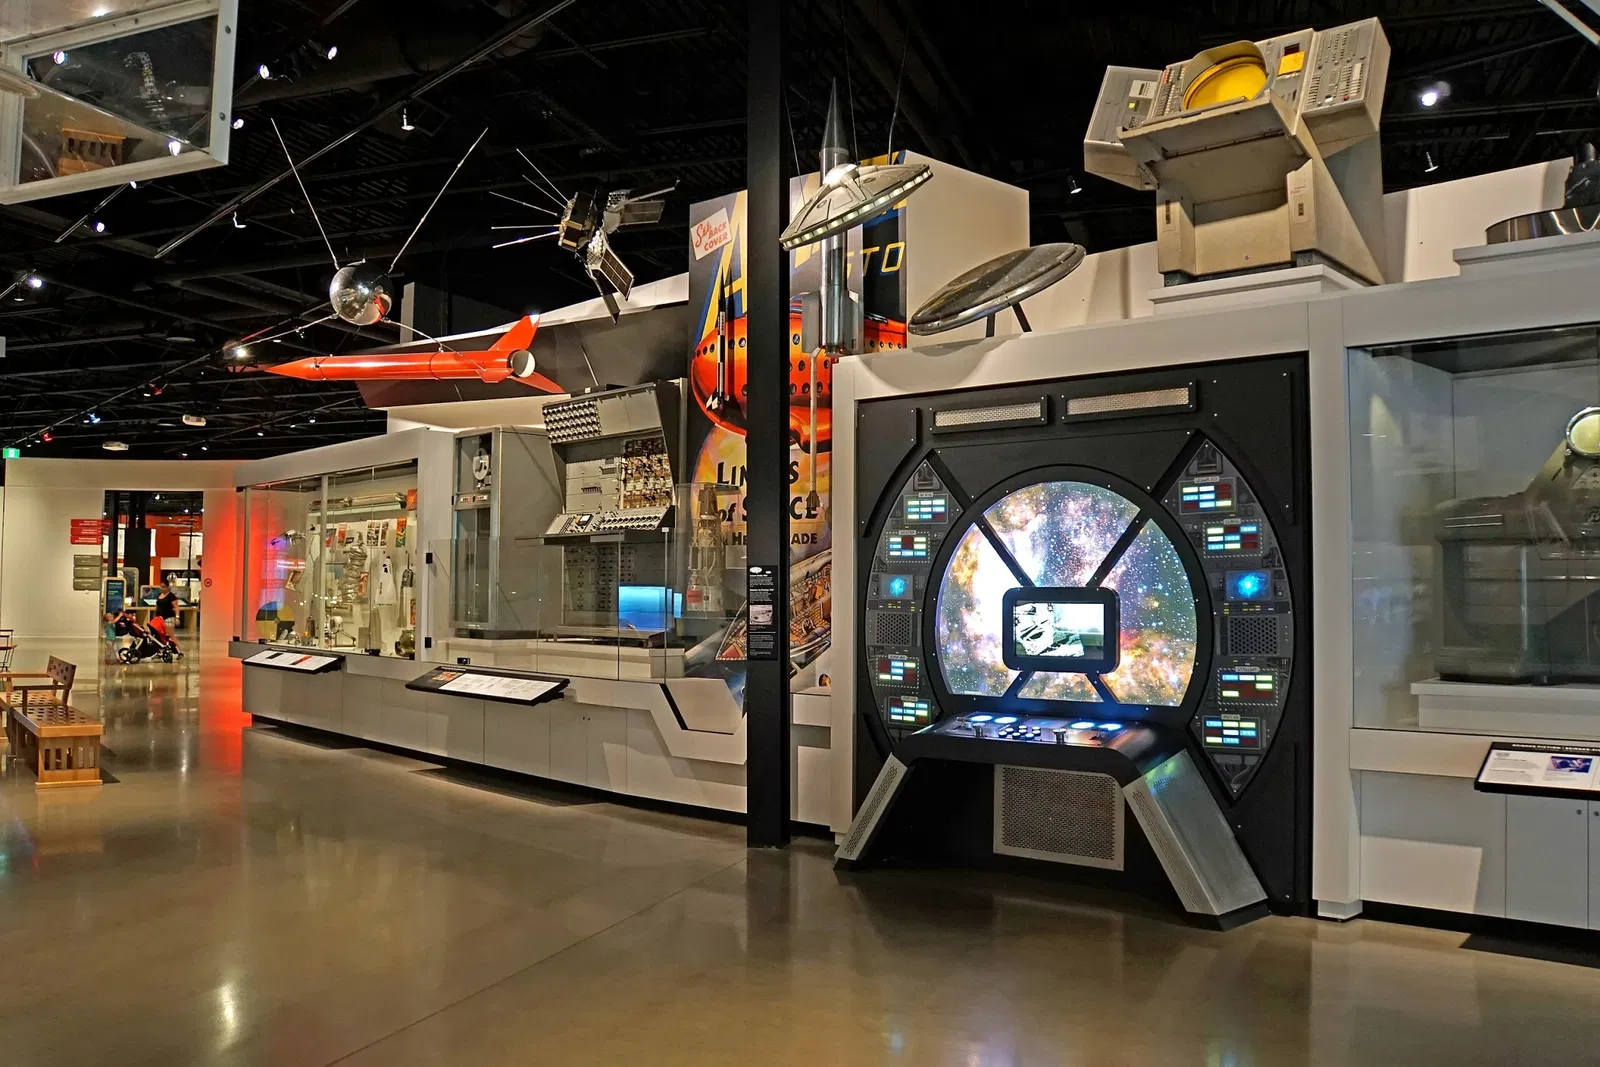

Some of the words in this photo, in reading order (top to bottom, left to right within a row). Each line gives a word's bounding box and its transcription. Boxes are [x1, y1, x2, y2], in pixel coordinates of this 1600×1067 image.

[708, 220, 727, 240] BACK
[704, 232, 728, 251] COVER
[717, 502, 737, 522] of
